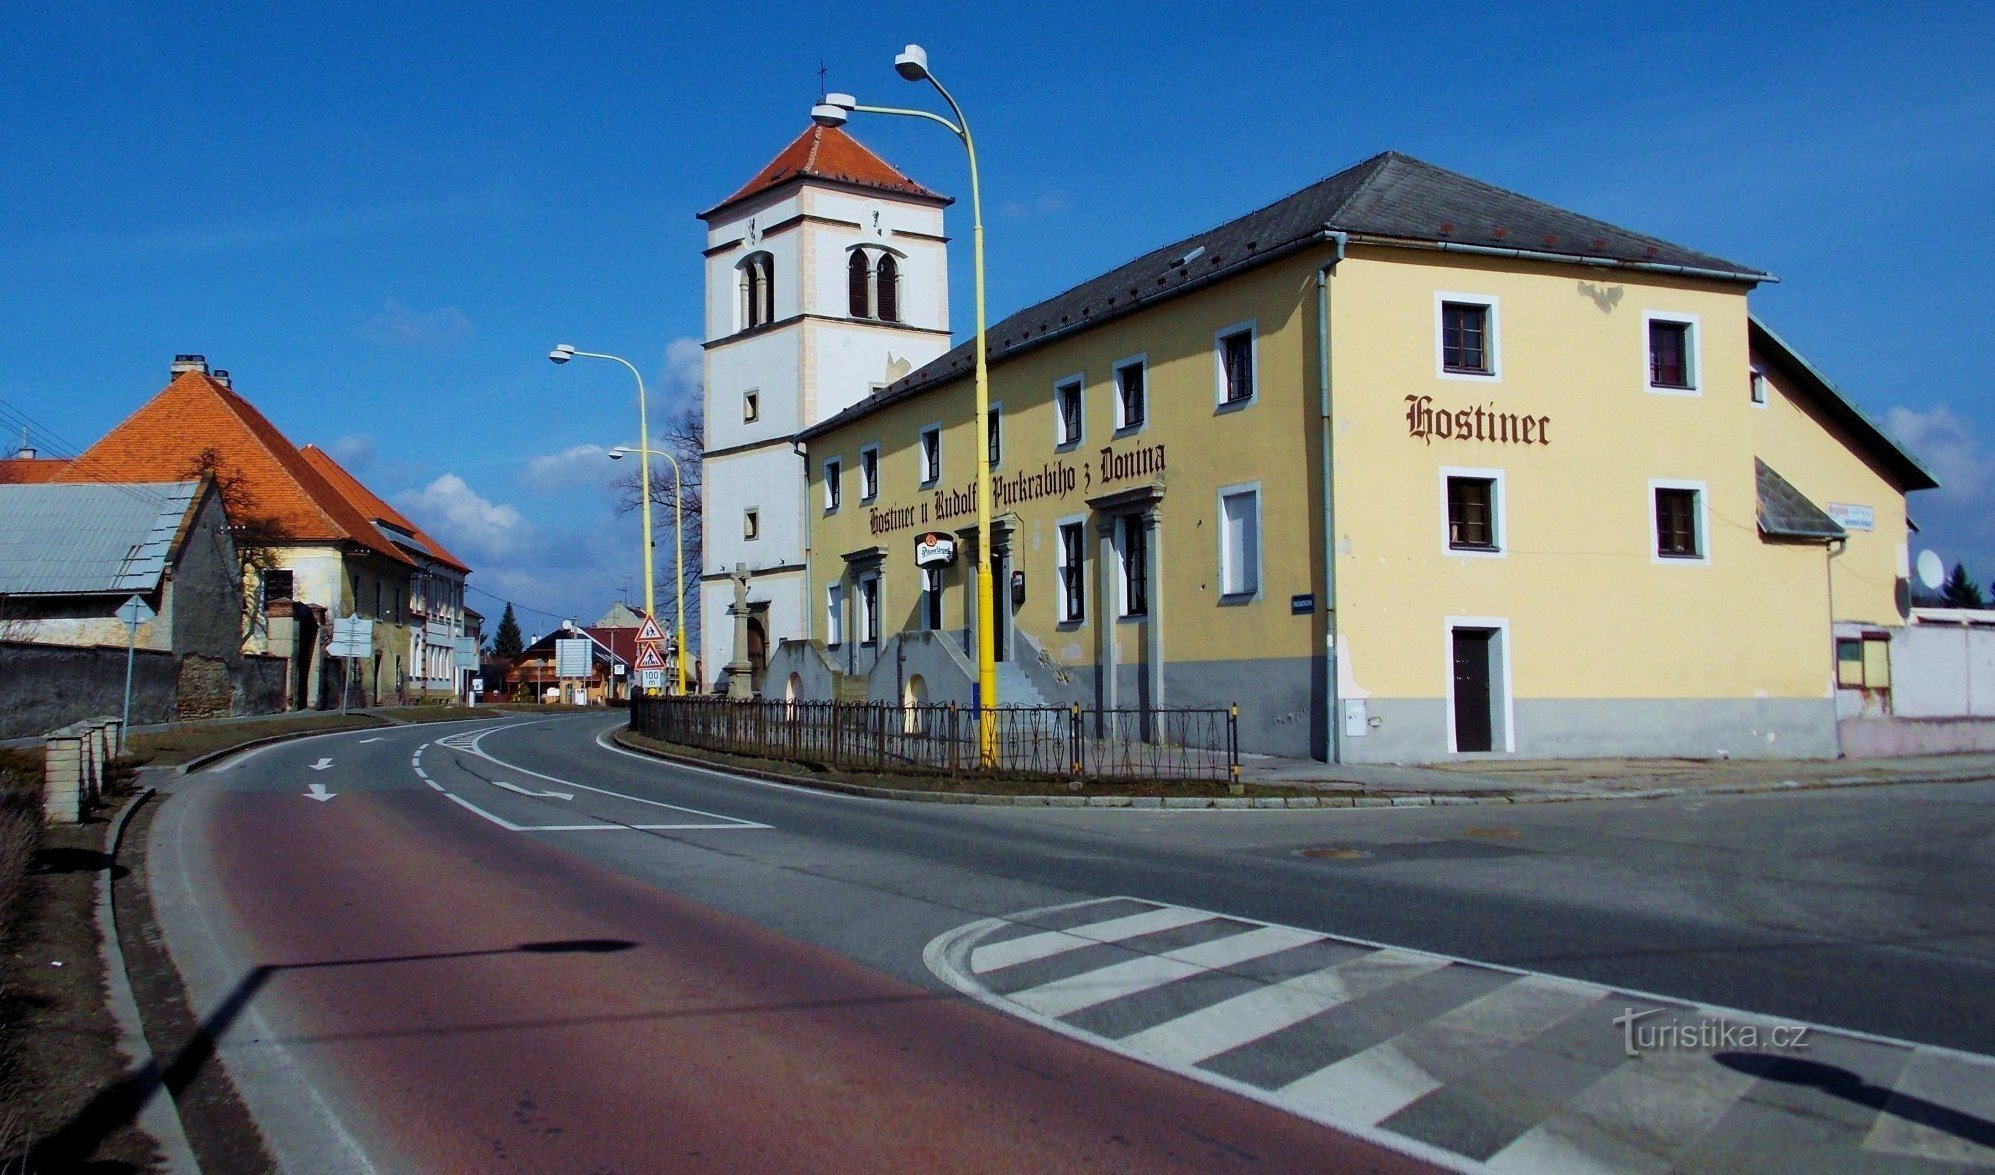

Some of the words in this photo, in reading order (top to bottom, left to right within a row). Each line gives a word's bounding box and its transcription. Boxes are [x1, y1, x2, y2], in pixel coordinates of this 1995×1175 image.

[1403, 394, 1552, 447] Hostinec
[869, 502, 915, 538] Hostinec
[921, 502, 928, 524] u
[934, 481, 980, 521] Rudolf
[645, 671, 659, 680] 100
